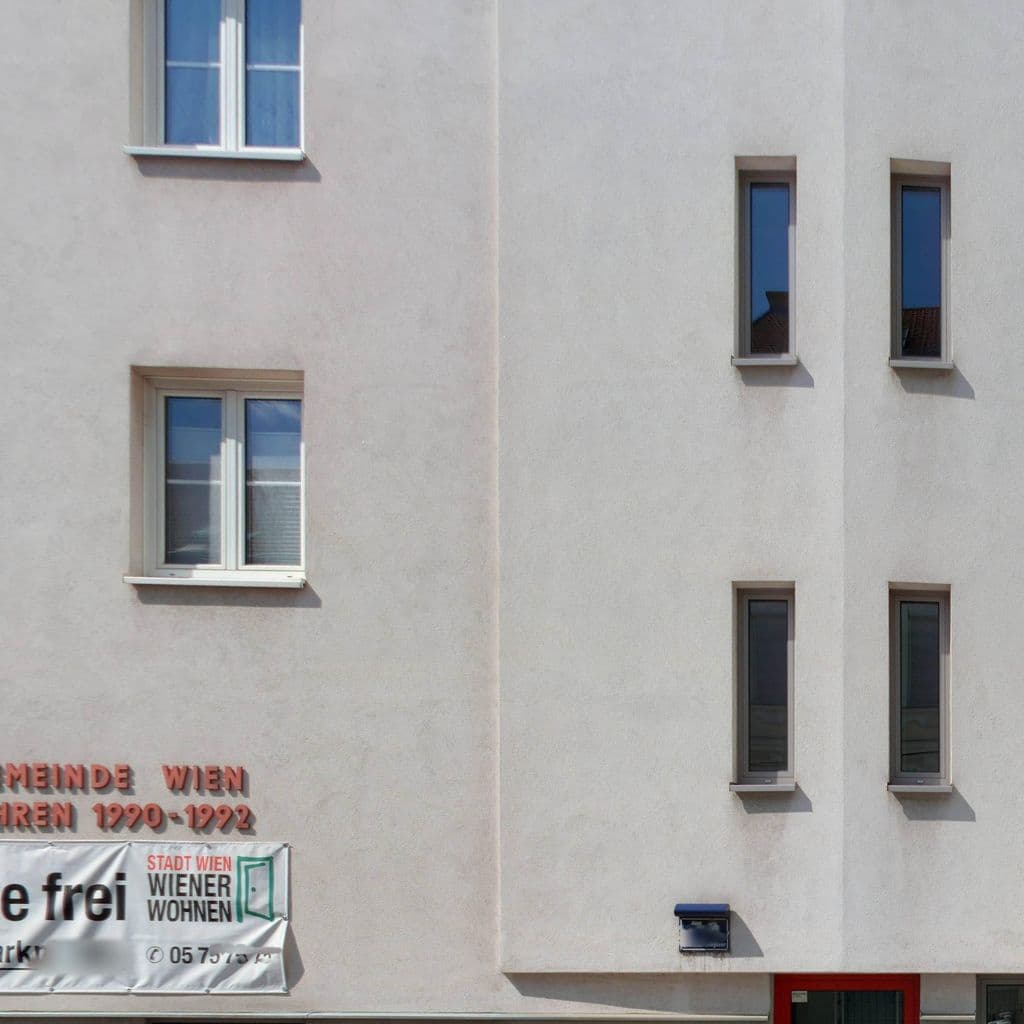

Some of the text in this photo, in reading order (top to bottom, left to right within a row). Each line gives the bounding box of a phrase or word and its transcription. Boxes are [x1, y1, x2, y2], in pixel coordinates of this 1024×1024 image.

[161, 765, 245, 791] WIEN
[147, 855, 232, 871] STADT WIEN
[147, 873, 232, 897] WIENER
[42, 873, 126, 921] frei
[147, 899, 233, 922] WOHNEN
[169, 946, 193, 964] 05
